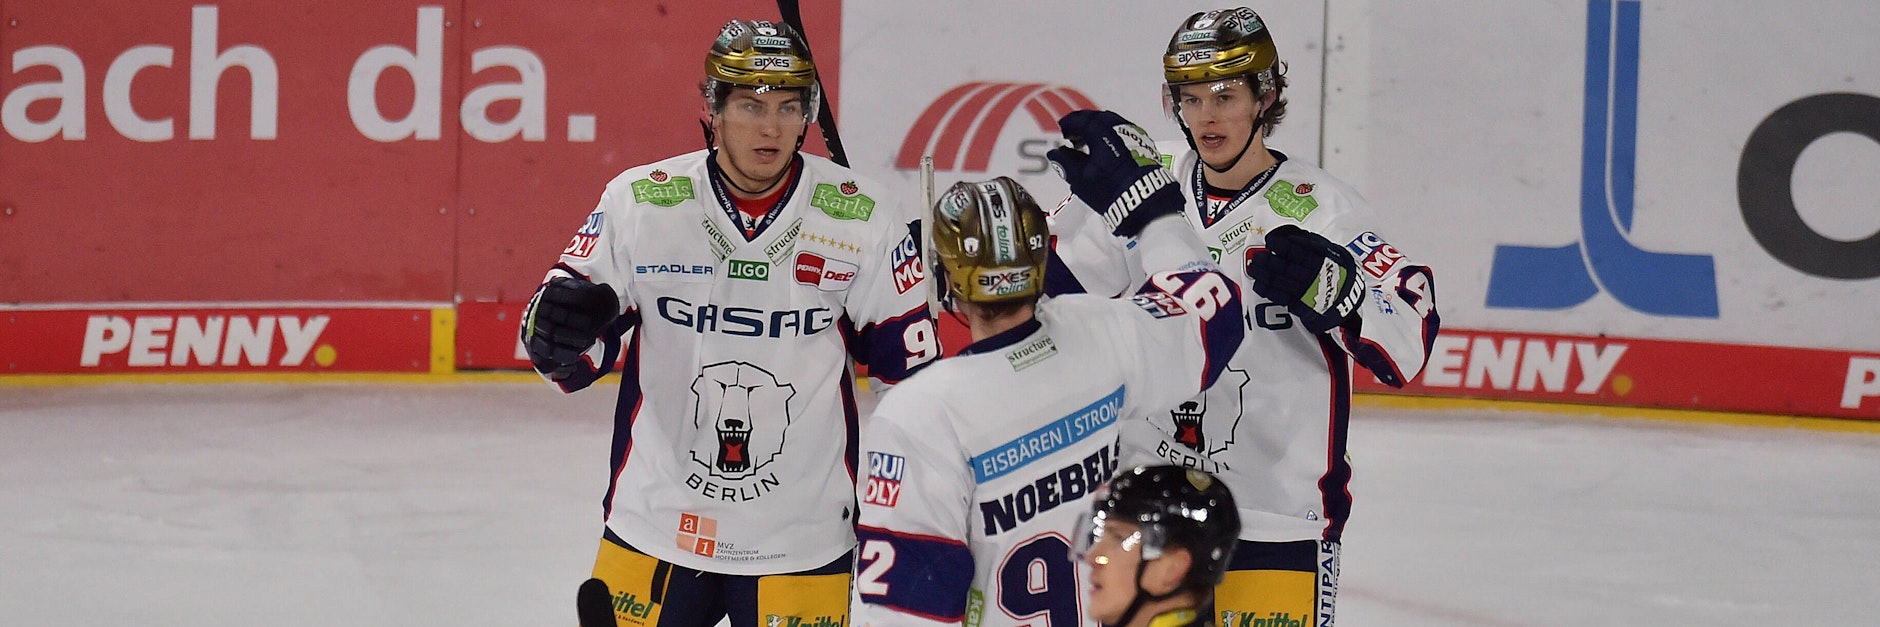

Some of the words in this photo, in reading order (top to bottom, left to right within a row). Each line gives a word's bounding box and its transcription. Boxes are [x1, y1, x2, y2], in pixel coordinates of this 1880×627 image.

[1, 5, 279, 143] ach
[347, 5, 597, 143] da.
[637, 182, 690, 199] Karls
[819, 189, 869, 218] Karls
[635, 264, 714, 275] STADLER
[728, 262, 768, 278] LIGO
[657, 296, 834, 338] GASAG
[981, 427, 1063, 477] EISBÄREN
[686, 472, 780, 502] BERLIN
